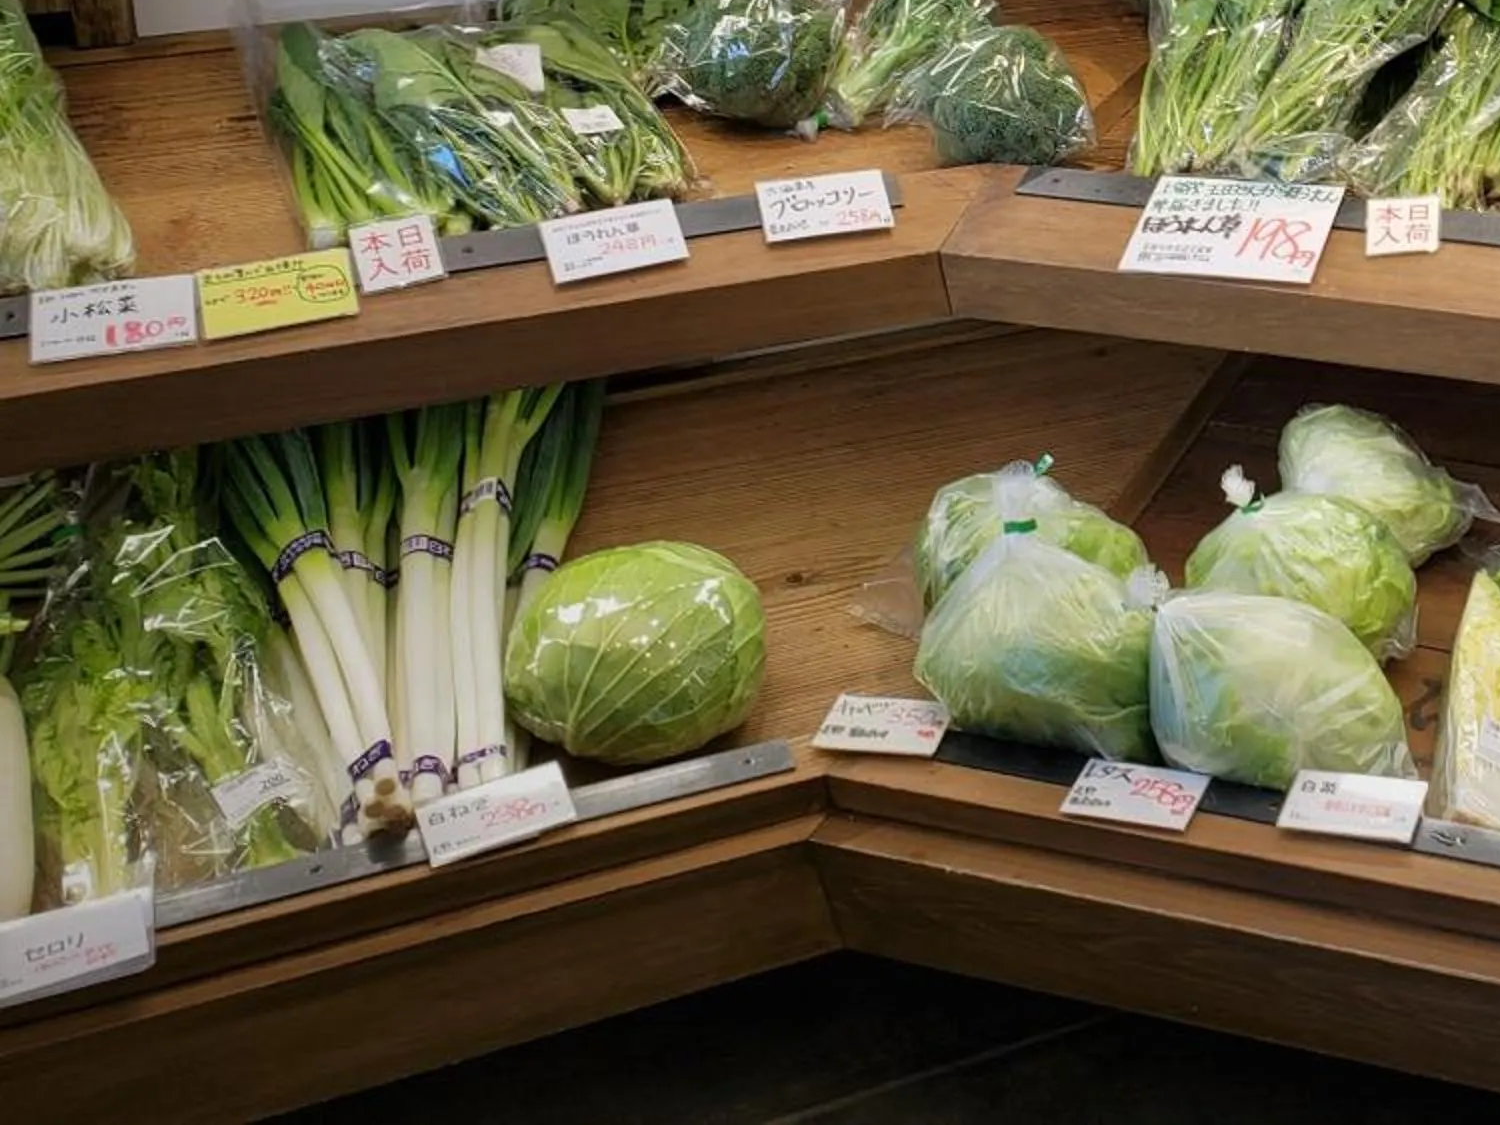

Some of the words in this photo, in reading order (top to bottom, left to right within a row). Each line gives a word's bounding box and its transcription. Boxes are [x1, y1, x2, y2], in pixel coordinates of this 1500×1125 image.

[769, 186, 877, 220] ブロッコリー
[50, 295, 138, 324] 小松菜
[25, 932, 84, 962] セロリ
